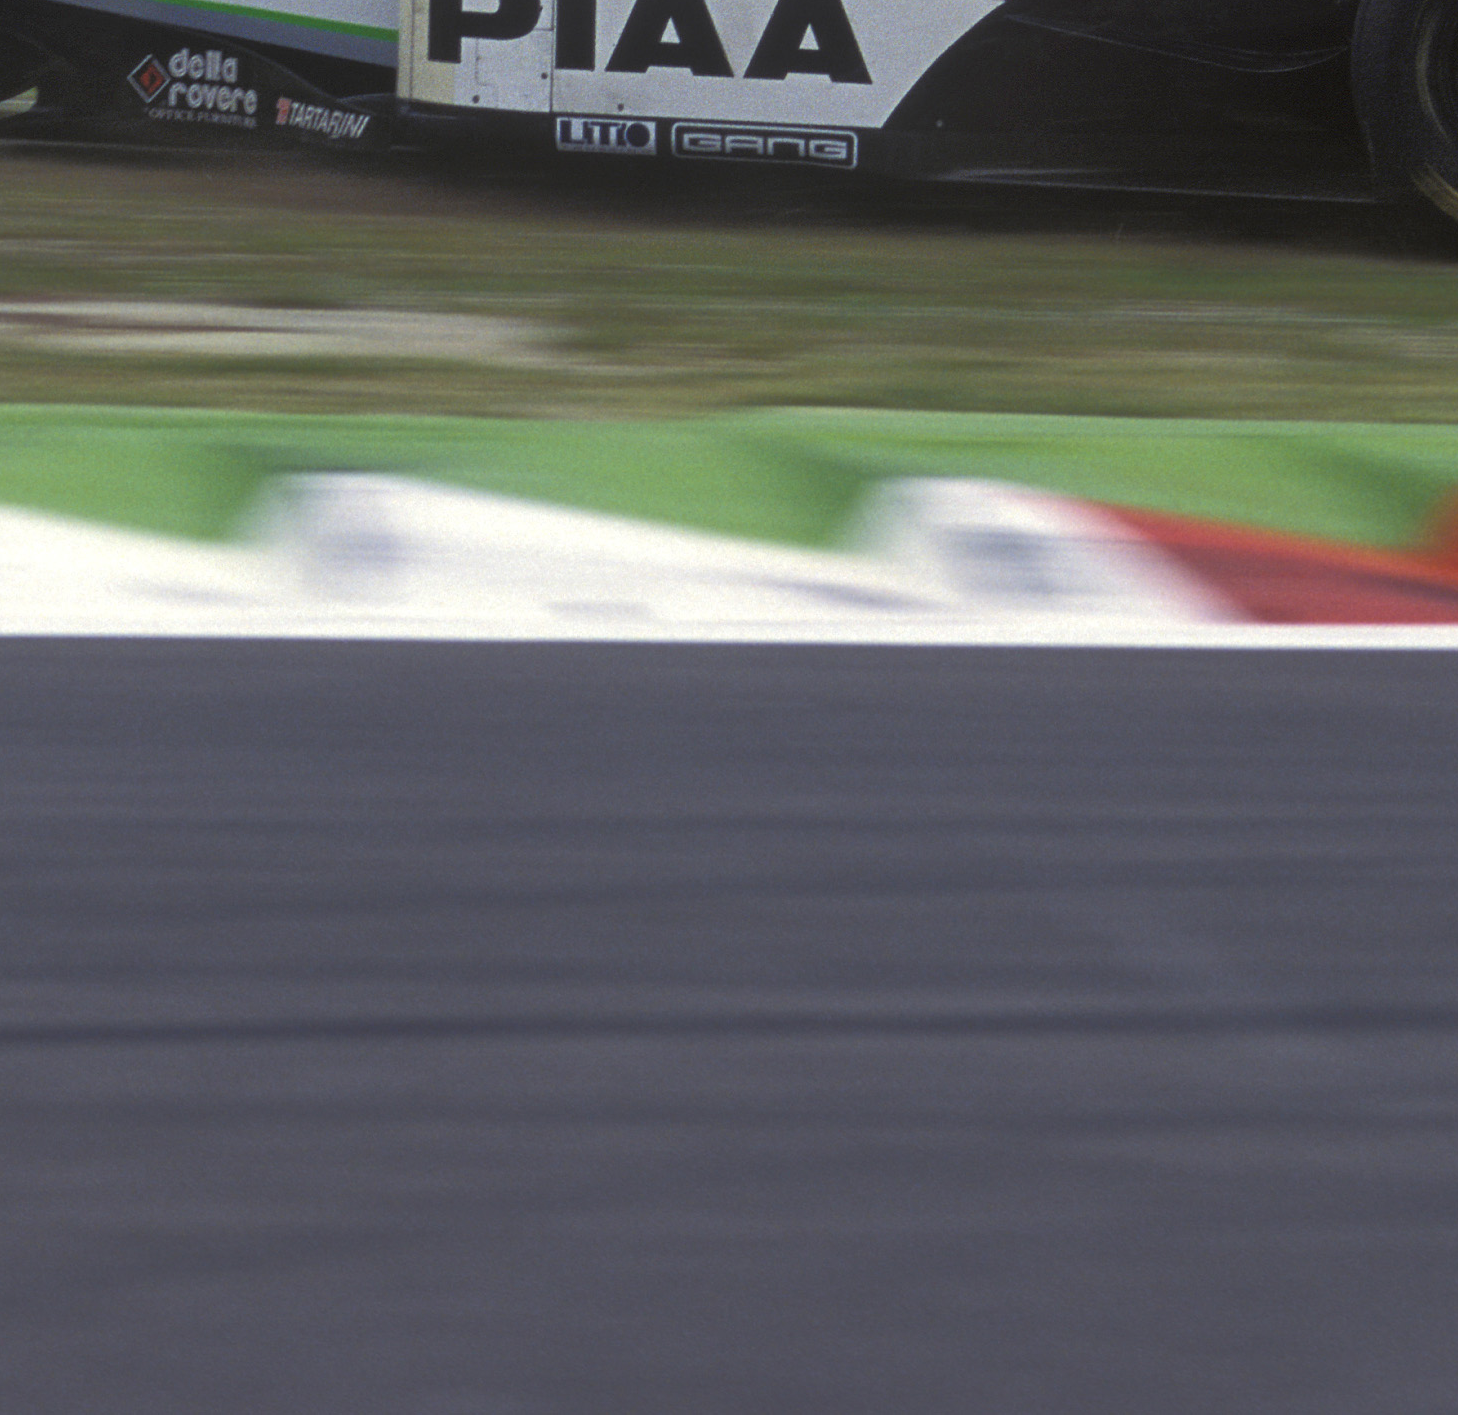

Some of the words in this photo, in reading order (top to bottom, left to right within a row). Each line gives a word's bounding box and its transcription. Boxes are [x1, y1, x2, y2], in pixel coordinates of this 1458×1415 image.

[168, 48, 239, 83] della
[168, 82, 258, 115] rovere
[288, 101, 371, 139] TARTARINI
